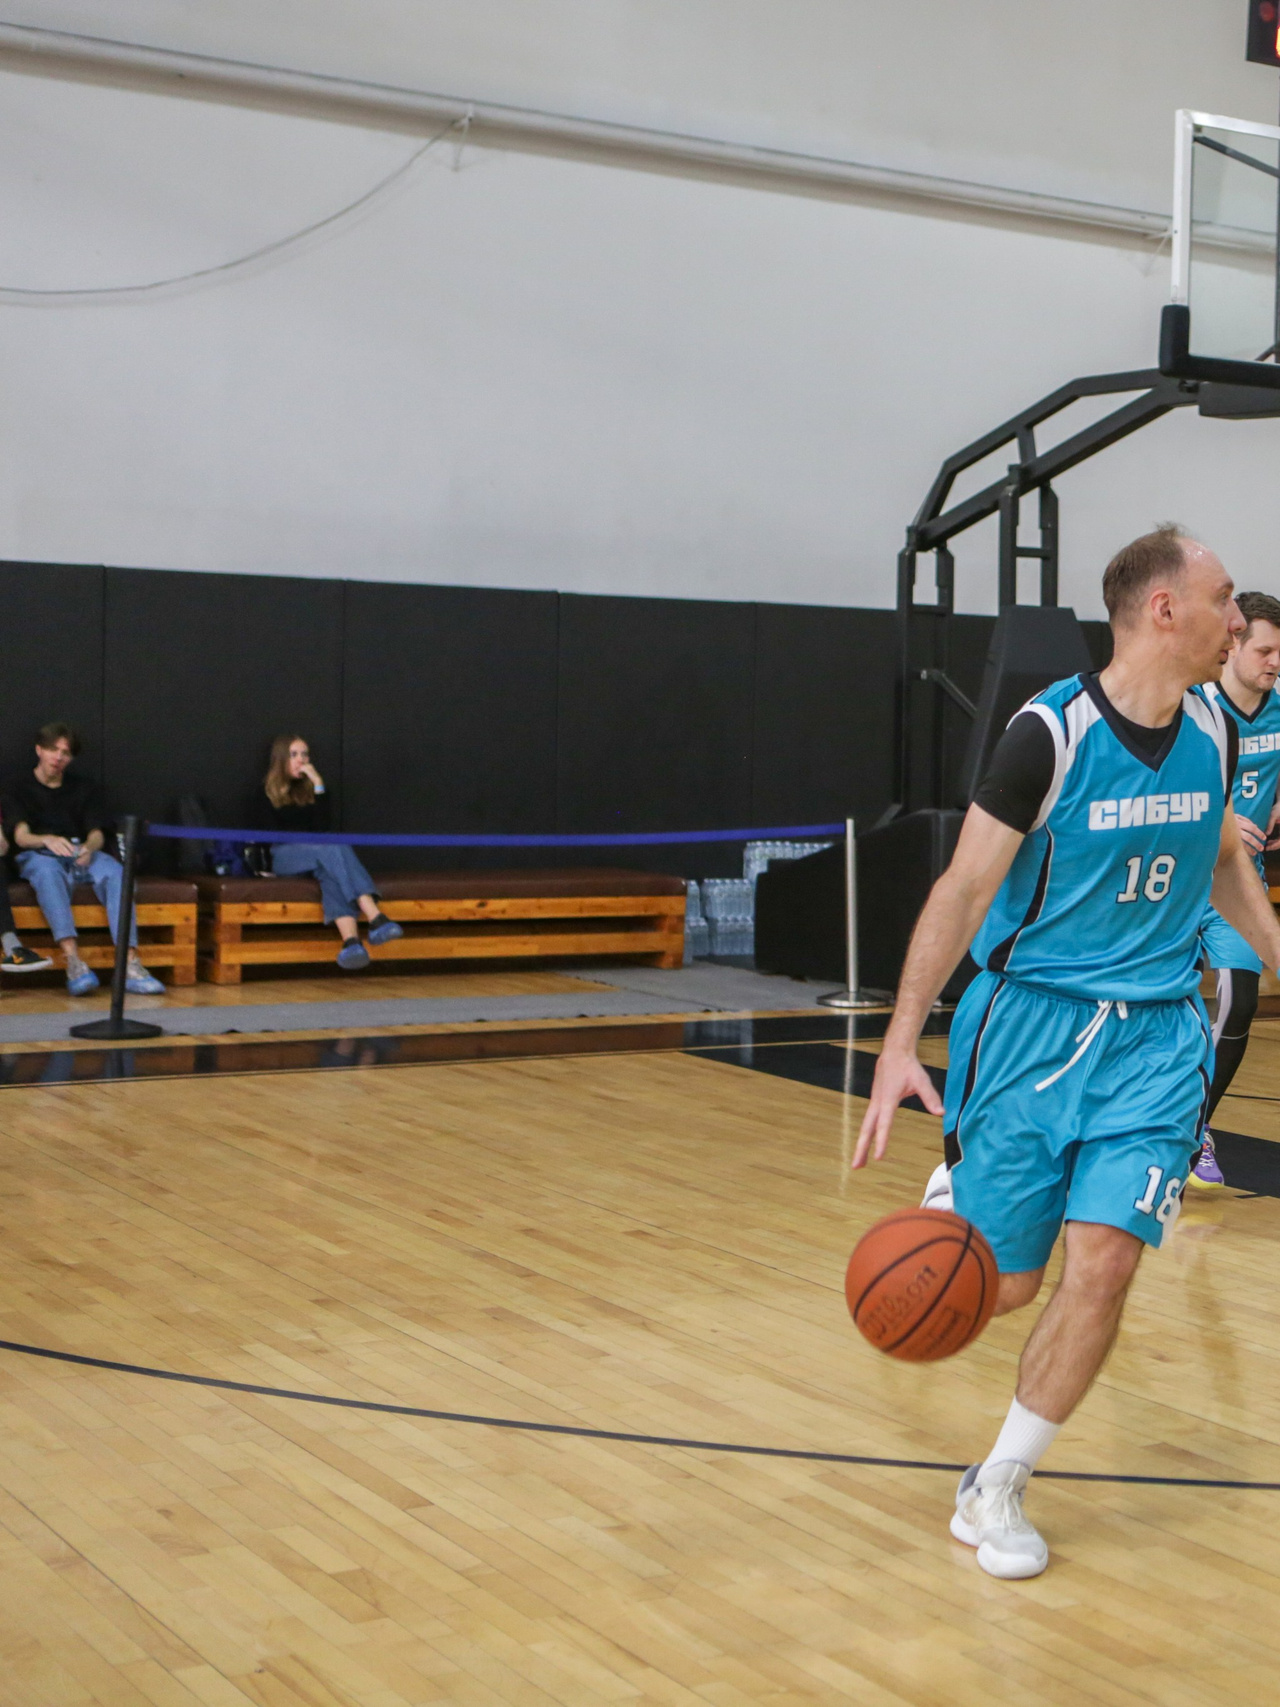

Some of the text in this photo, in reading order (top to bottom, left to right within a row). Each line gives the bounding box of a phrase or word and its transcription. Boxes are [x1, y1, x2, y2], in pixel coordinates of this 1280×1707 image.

[1241, 770, 1259, 799] 5
[1088, 792, 1210, 831] СИБУР
[1115, 853, 1177, 904] 18
[1132, 1164, 1182, 1226] 18
